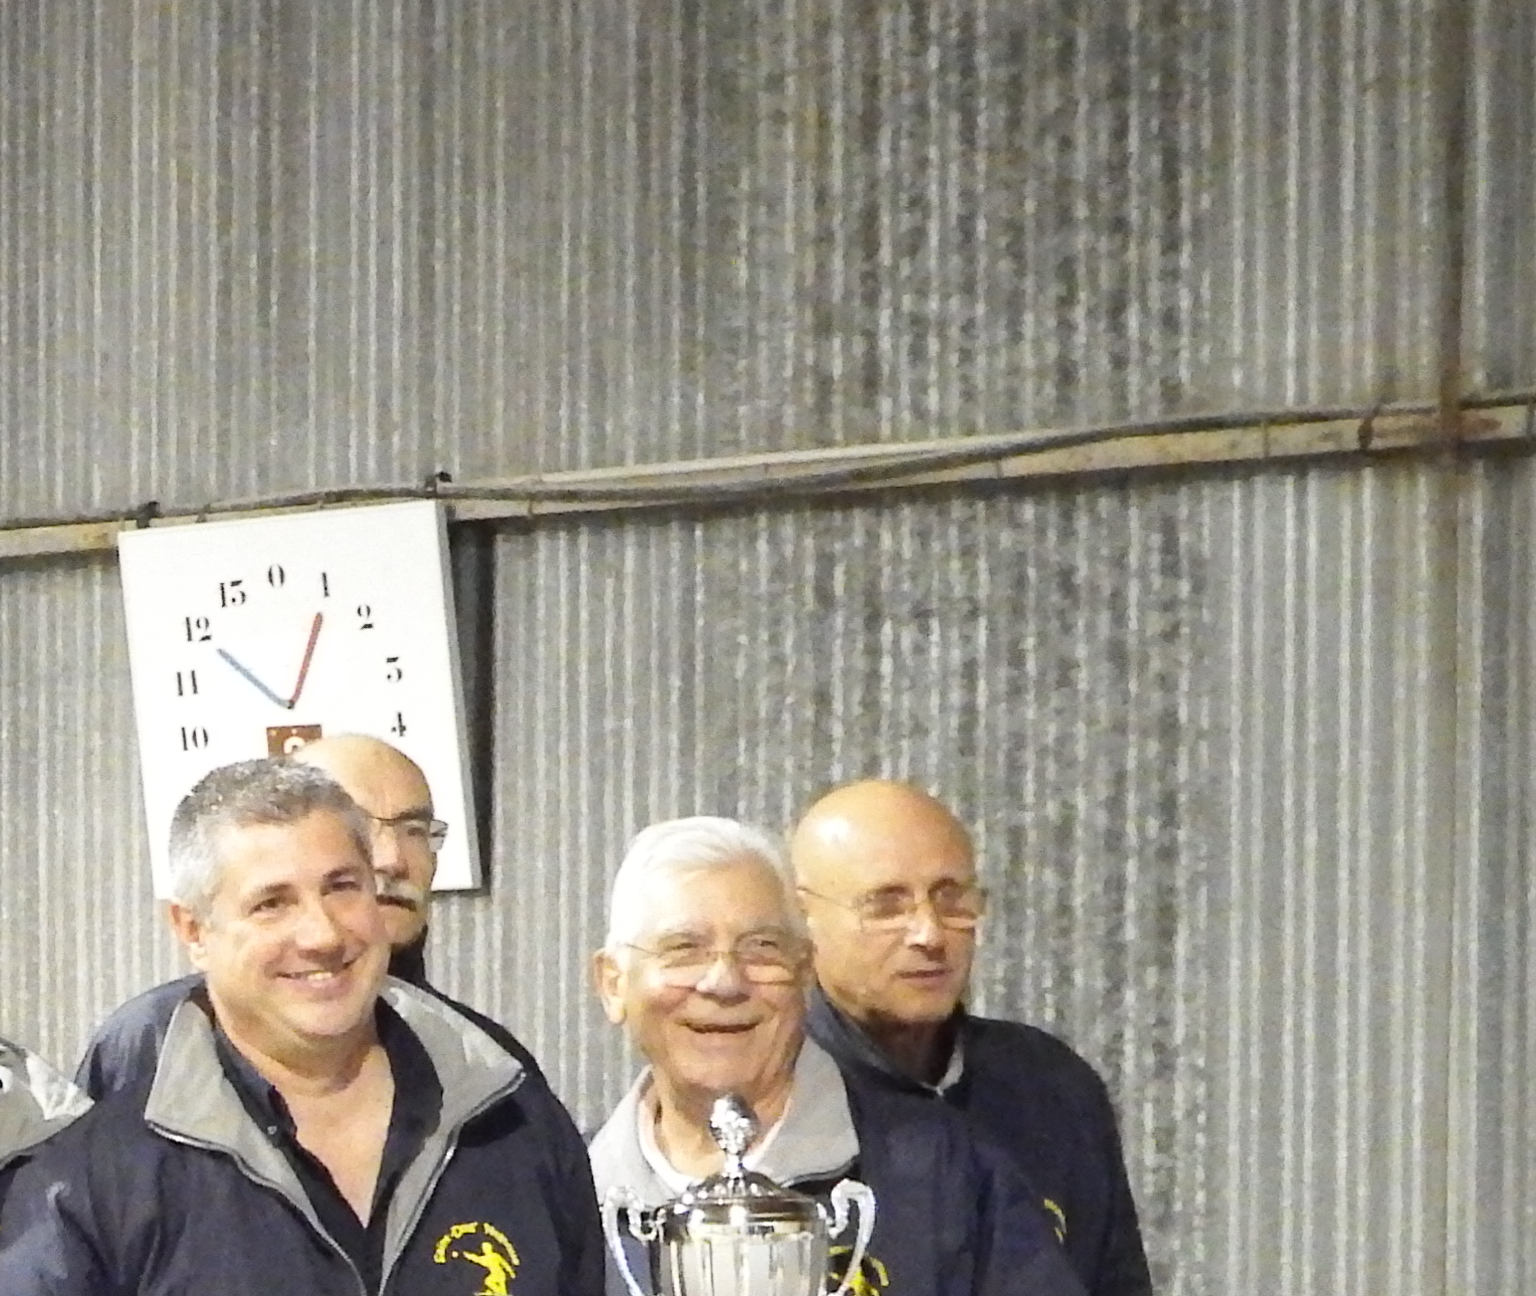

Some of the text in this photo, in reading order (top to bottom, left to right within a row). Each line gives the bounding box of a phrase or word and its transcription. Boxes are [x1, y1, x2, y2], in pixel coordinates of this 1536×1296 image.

[268, 564, 285, 588] 0
[322, 572, 330, 598] 1
[184, 615, 212, 643] 12
[357, 604, 374, 630] 2
[176, 669, 198, 697] 11
[390, 712, 407, 737] 4
[181, 726, 209, 751] 10
